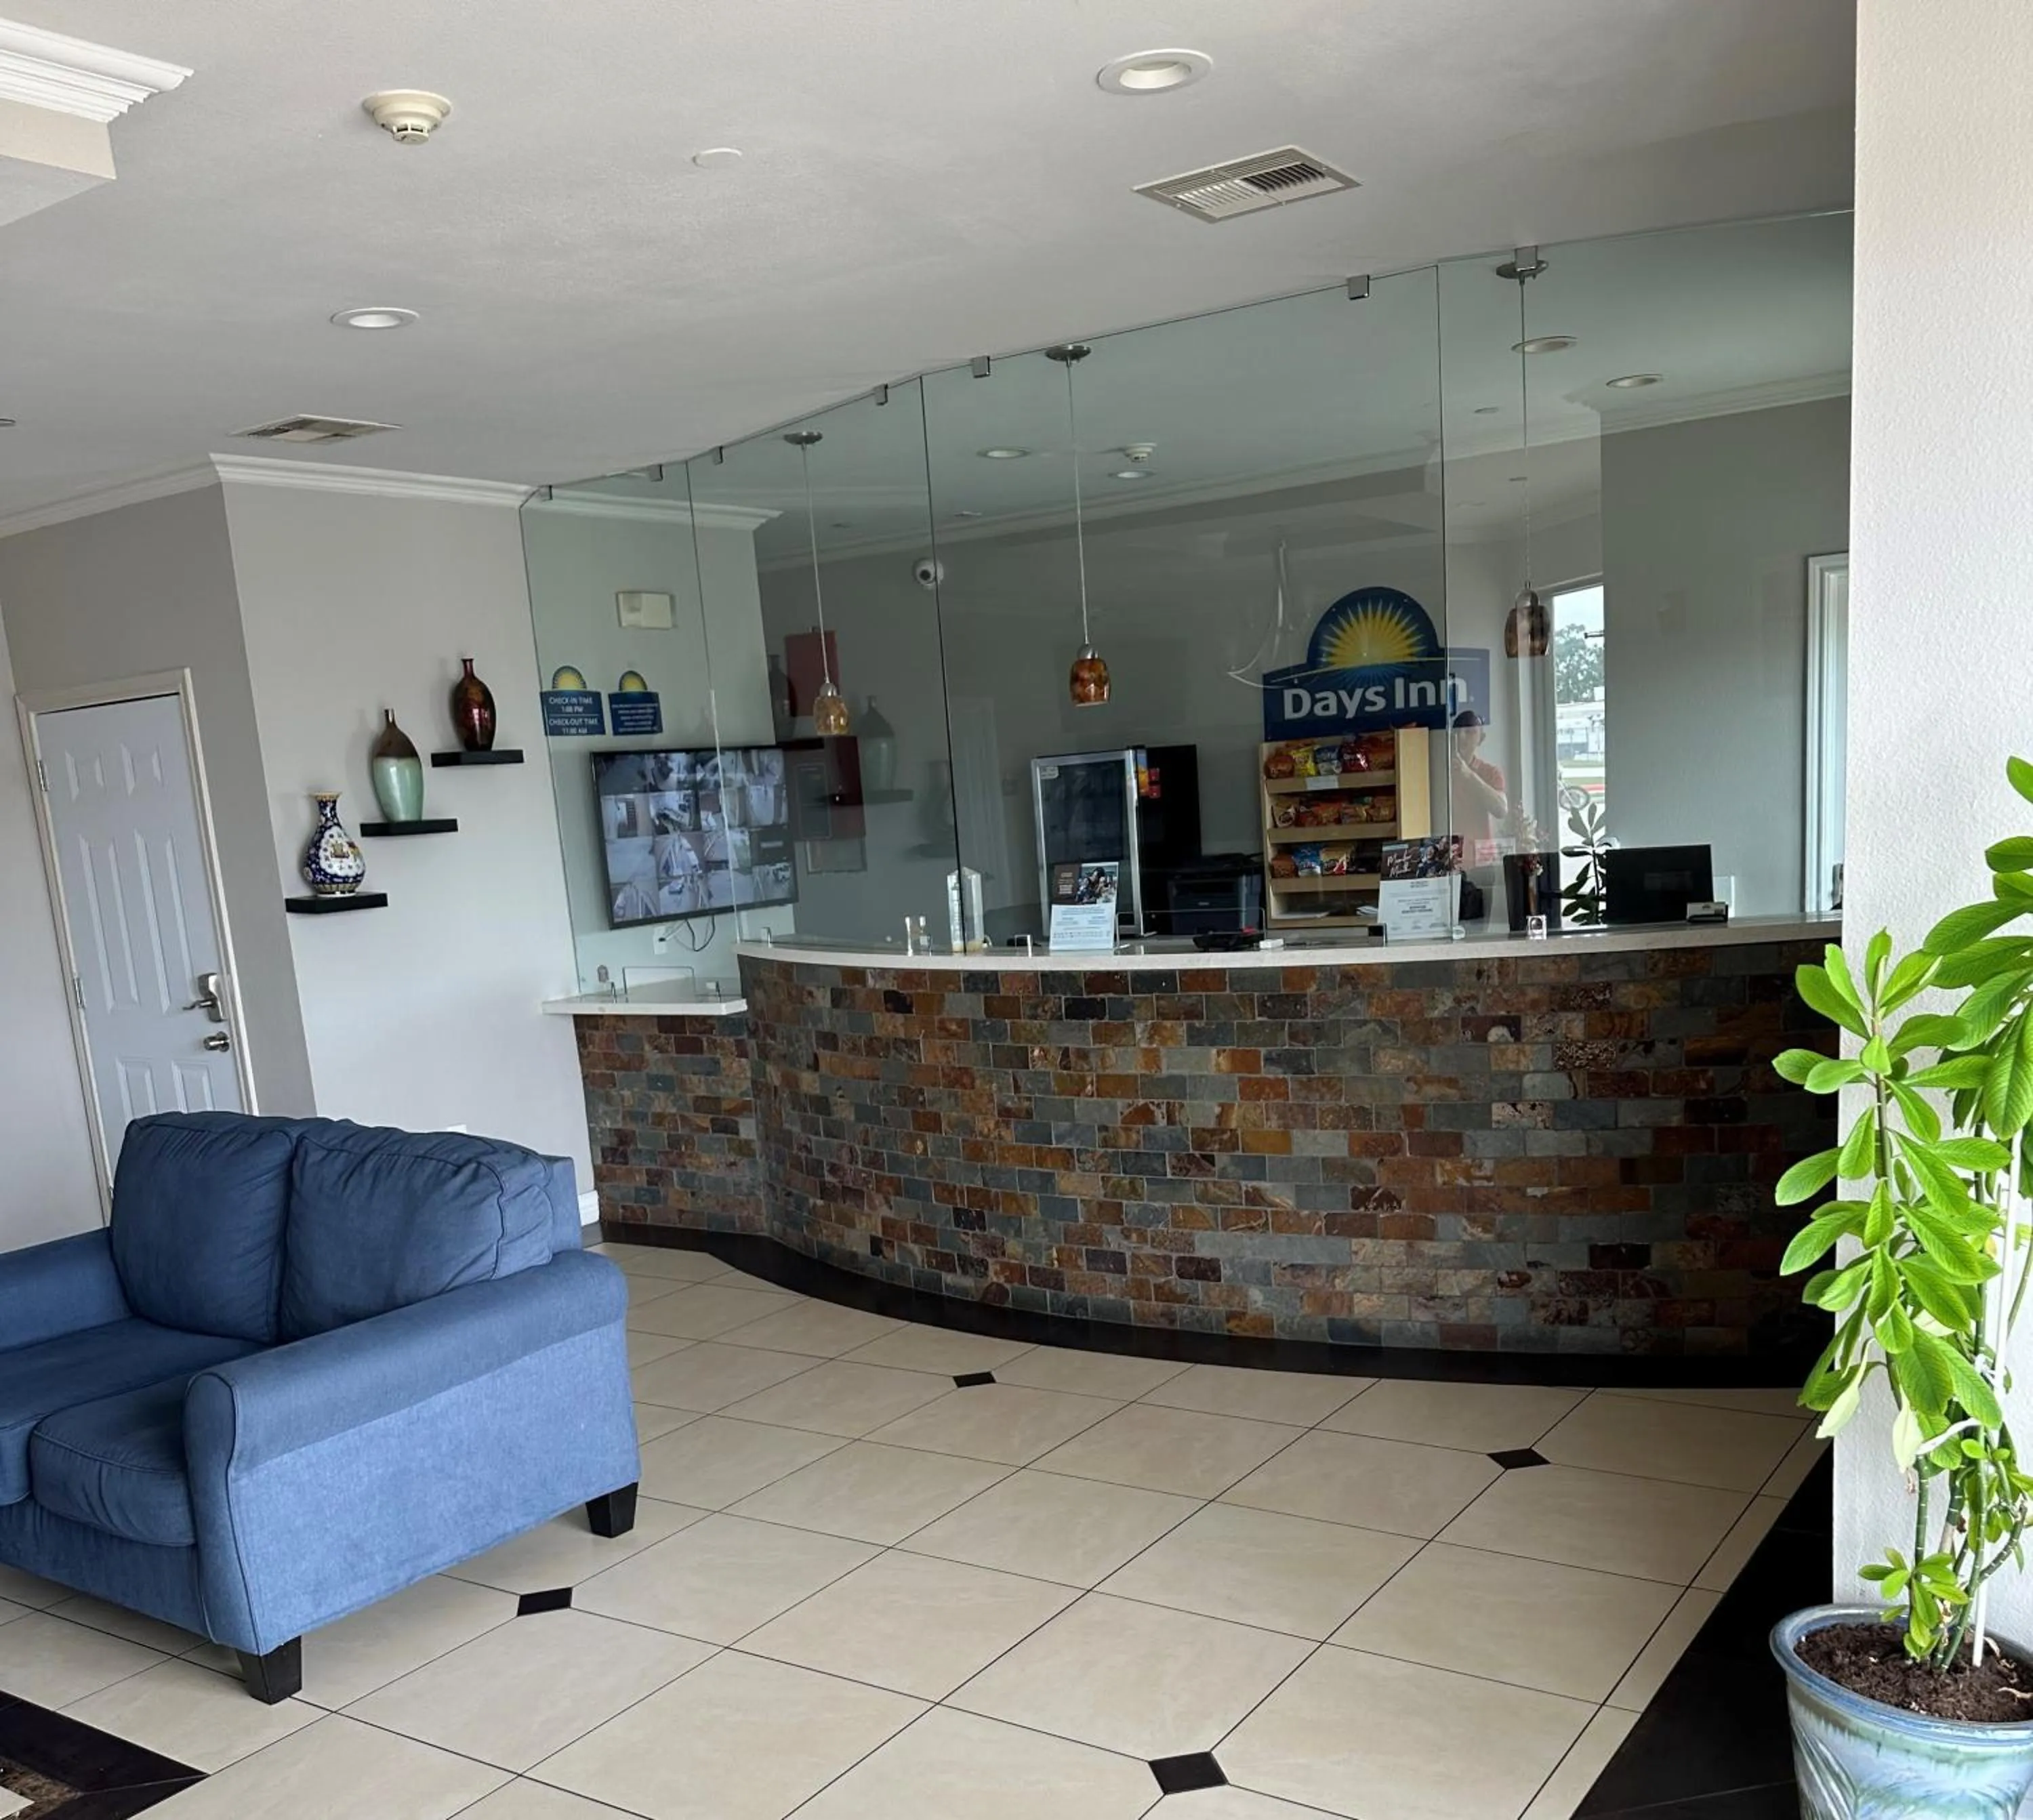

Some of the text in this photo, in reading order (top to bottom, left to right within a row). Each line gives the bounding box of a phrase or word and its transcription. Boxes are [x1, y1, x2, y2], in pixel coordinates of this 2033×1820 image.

[579, 696, 593, 705] TIME
[1283, 677, 1468, 720] Days Inn
[583, 718, 598, 726] TIME
